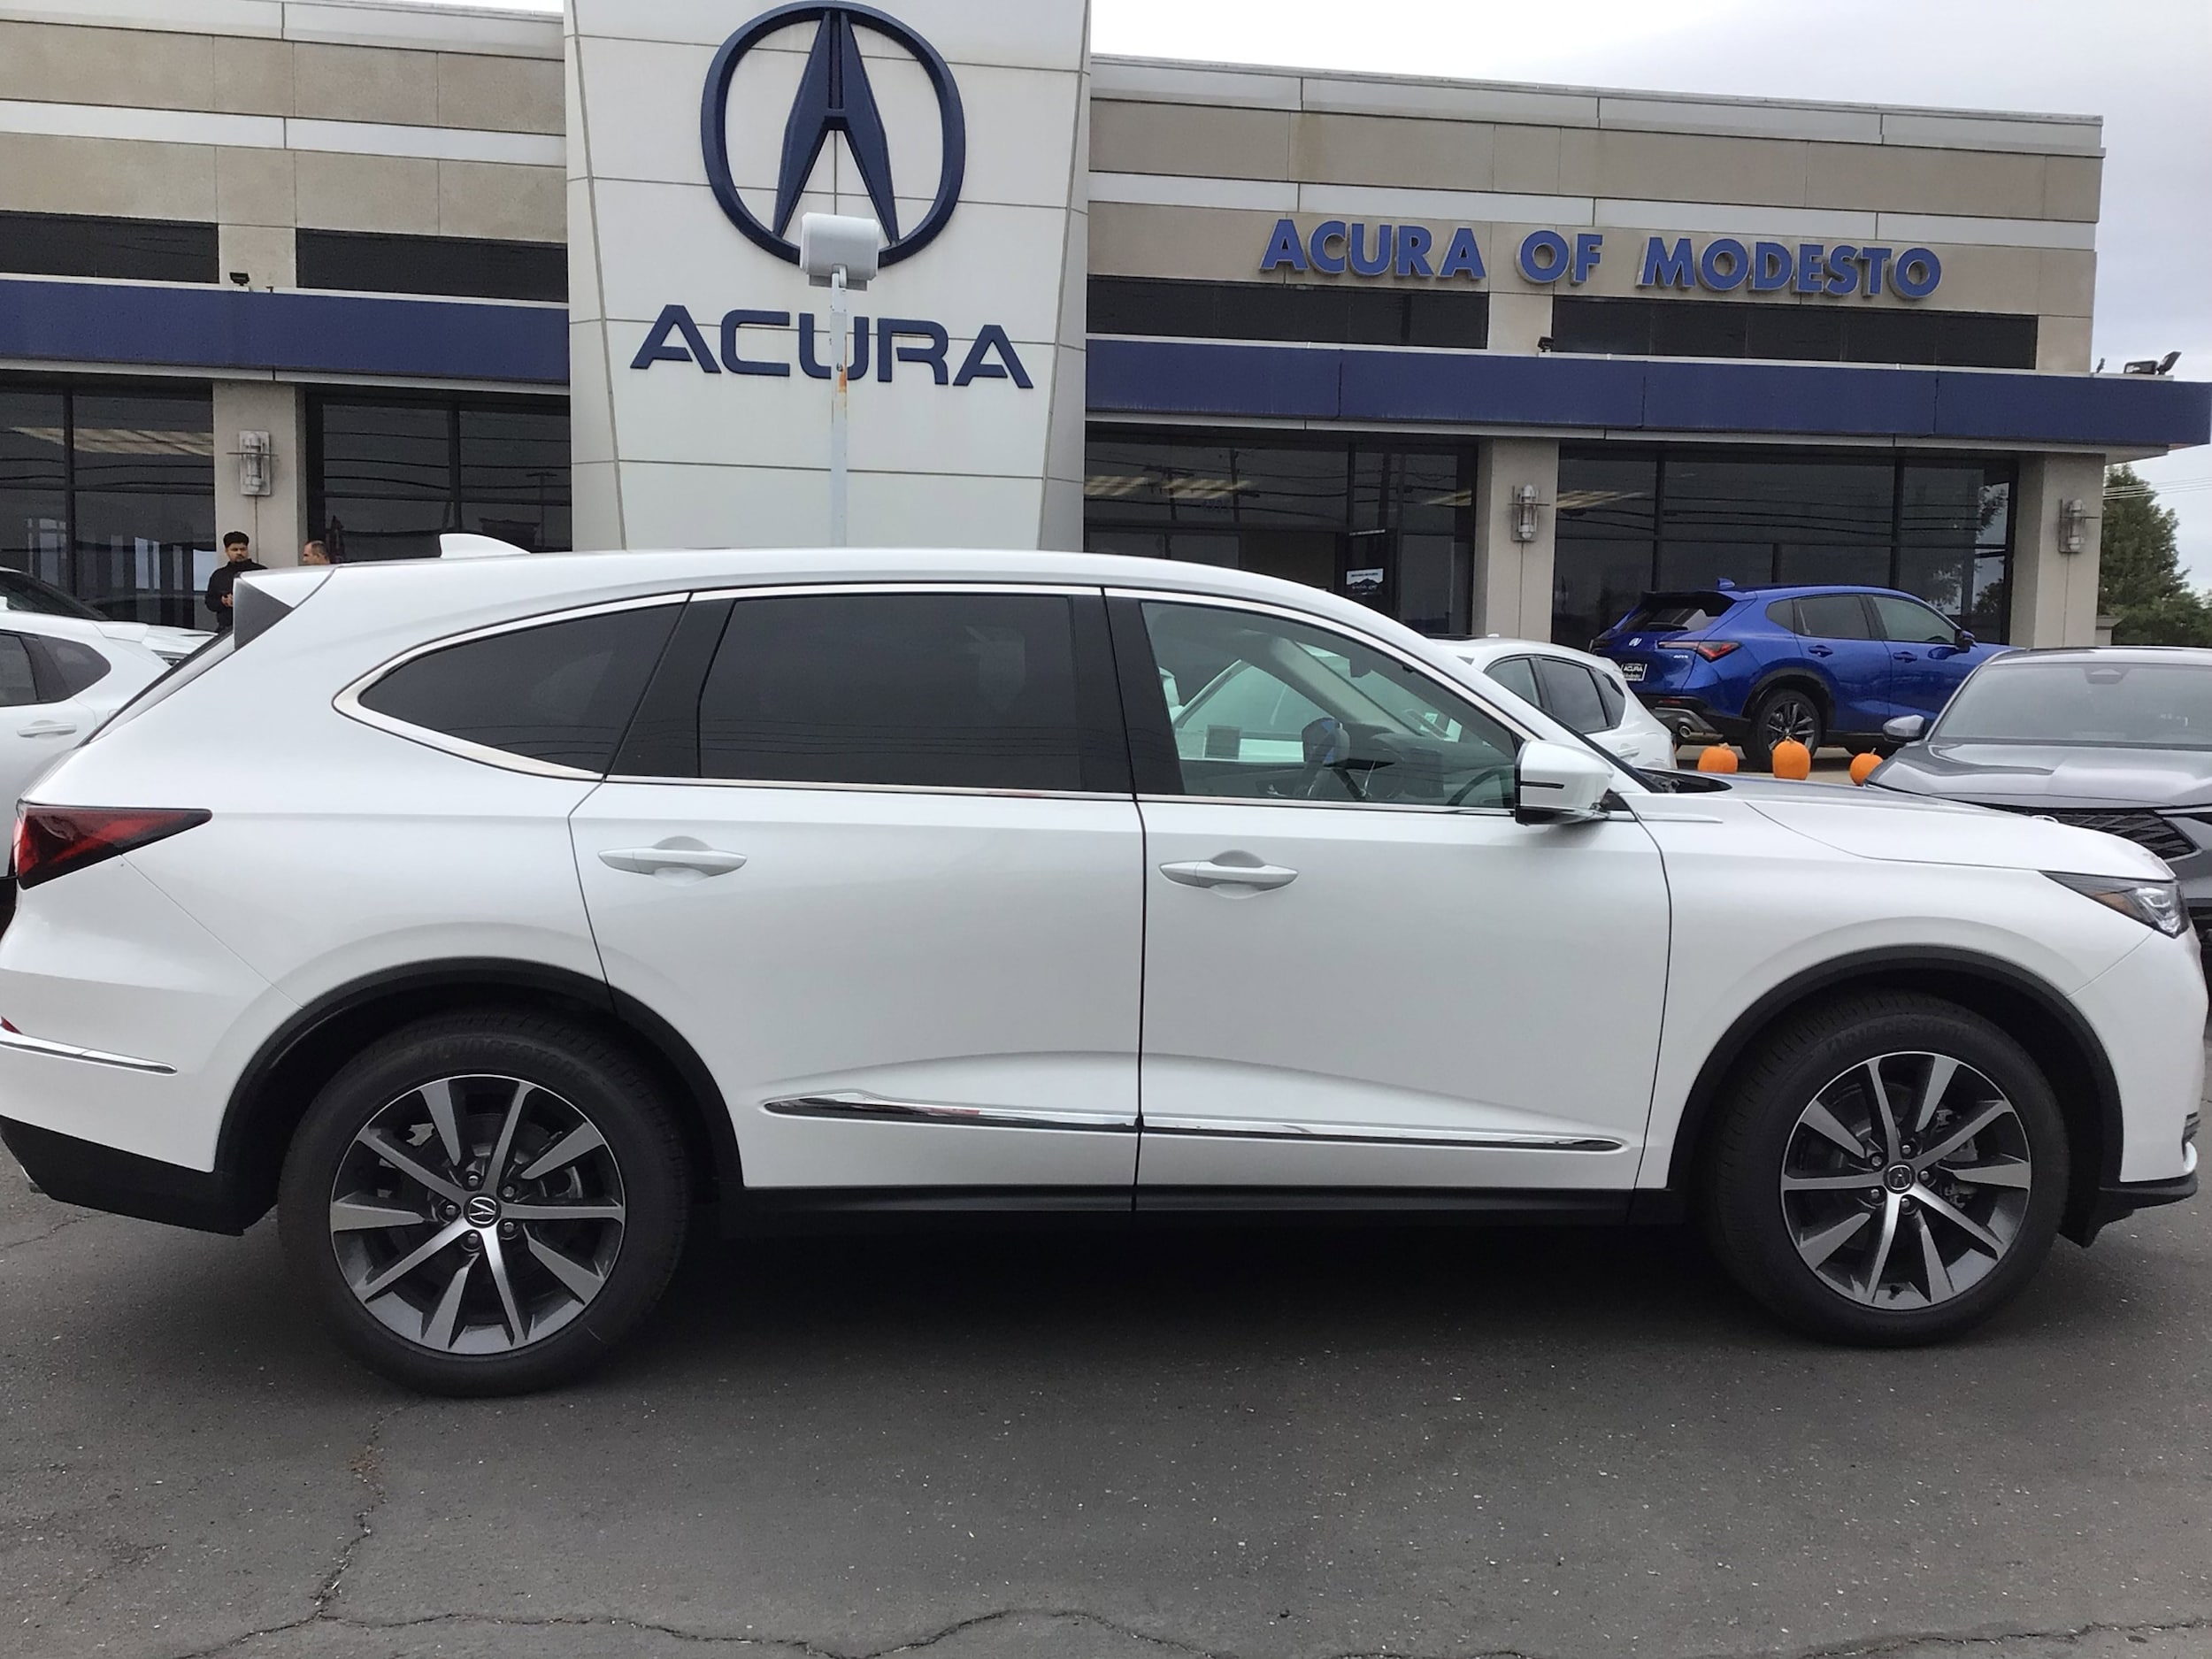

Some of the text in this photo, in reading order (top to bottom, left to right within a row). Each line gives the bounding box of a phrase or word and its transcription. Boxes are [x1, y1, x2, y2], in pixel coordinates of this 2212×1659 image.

[1260, 218, 1942, 300] ACURA OF MODESTO
[629, 303, 1034, 389] ACURA
